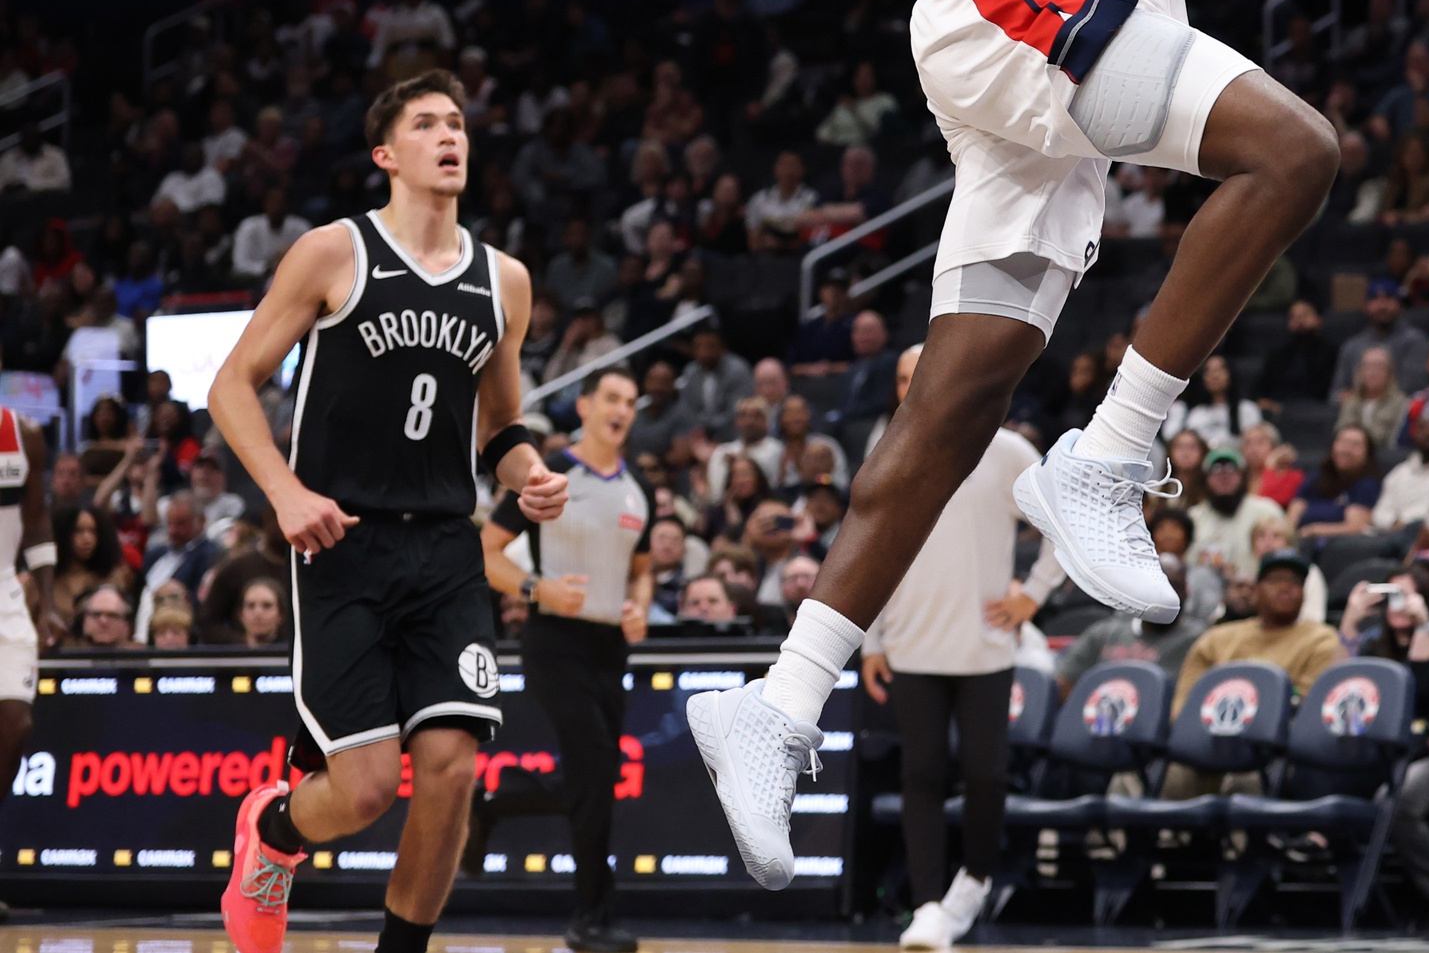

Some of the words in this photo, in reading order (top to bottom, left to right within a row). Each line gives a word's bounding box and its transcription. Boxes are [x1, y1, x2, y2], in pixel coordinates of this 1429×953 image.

[357, 308, 494, 376] BROOKLYN
[403, 373, 438, 441] 8
[476, 652, 488, 689] B
[67, 736, 287, 808] powered
